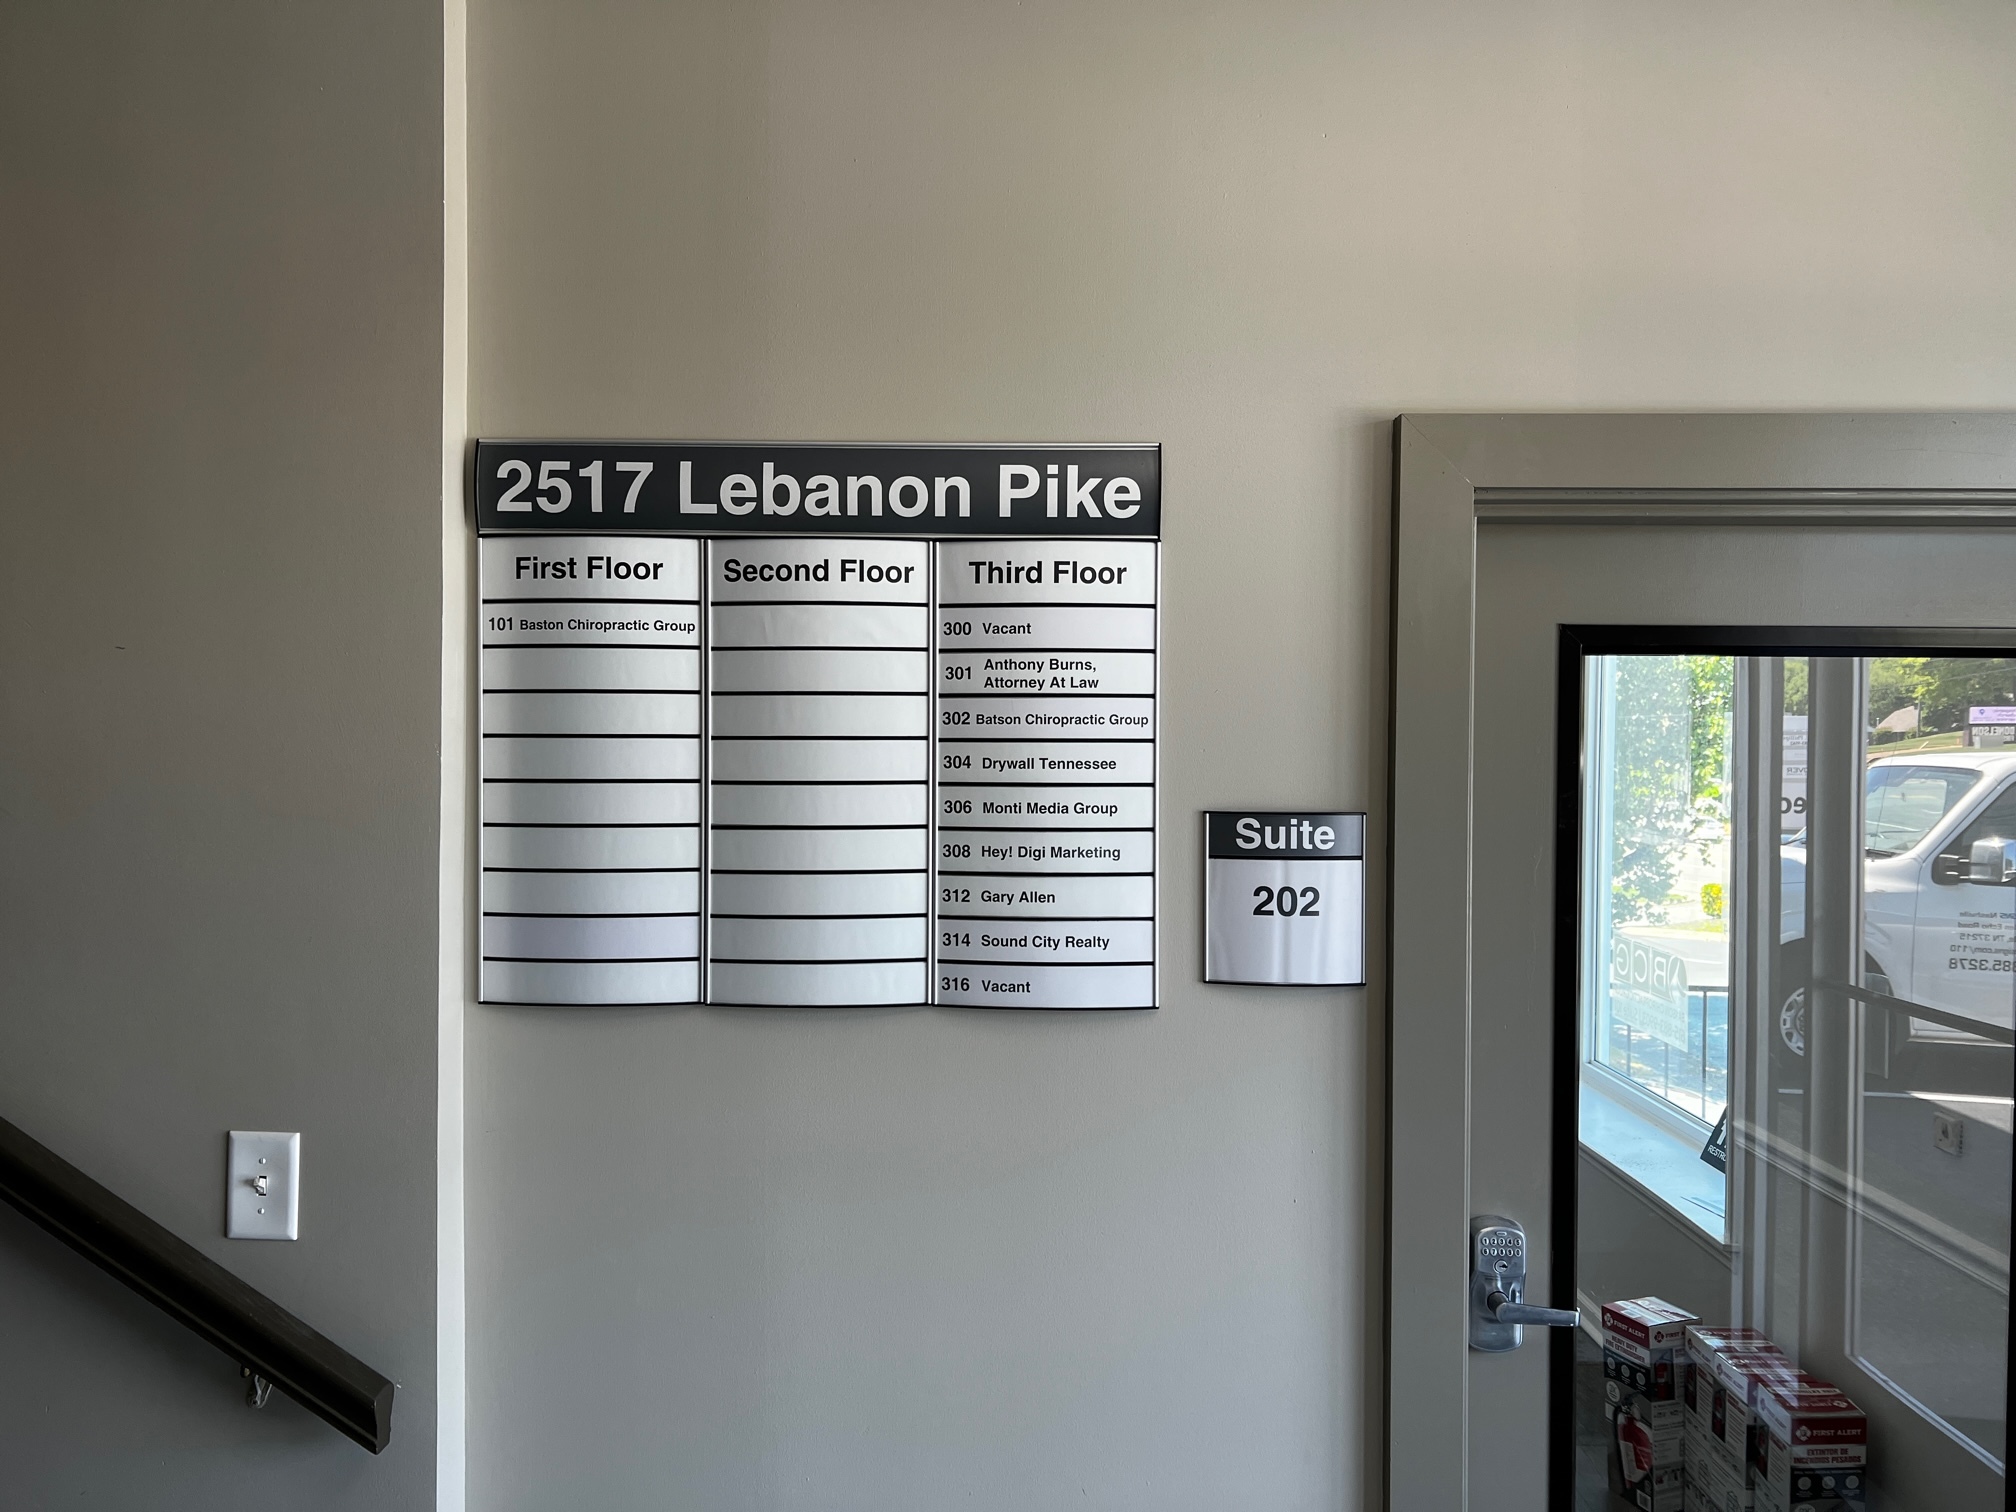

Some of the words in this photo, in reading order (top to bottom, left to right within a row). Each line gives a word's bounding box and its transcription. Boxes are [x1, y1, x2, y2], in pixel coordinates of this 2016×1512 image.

[497, 460, 653, 513] 2517
[680, 461, 970, 517] Lebanon
[1000, 465, 1141, 518] Pike
[516, 557, 577, 579] First
[588, 556, 663, 579] Floor
[724, 559, 828, 582] Second
[841, 559, 914, 583] Floor
[969, 561, 1042, 584] Third
[1054, 561, 1127, 584] Floor
[489, 617, 512, 630] 101
[520, 620, 563, 630] Baston
[568, 619, 649, 632] Chiropractic
[654, 620, 695, 634] Group
[944, 622, 971, 635] 300
[982, 623, 1031, 634] Vacant
[945, 667, 971, 680] 301
[984, 659, 1044, 673] Anthony
[1050, 659, 1095, 672] Burns,
[984, 677, 1045, 691] Attorney
[1050, 677, 1065, 688] At
[1071, 677, 1099, 688] Law
[943, 712, 970, 725] 302
[977, 714, 1020, 724] Batson
[1025, 714, 1105, 727] Chiropractic
[1109, 714, 1148, 727] Group
[944, 755, 971, 769] 304
[983, 758, 1034, 772] Drywall
[1039, 758, 1116, 769] Tennessee
[944, 800, 972, 813] 306
[983, 802, 1021, 813] Monti
[1027, 803, 1068, 814] Media
[1074, 803, 1117, 816] Group
[1236, 817, 1335, 850] Suite
[943, 844, 970, 858] 308
[982, 846, 1012, 860] Hey!
[1018, 846, 1045, 861] Digi
[1051, 847, 1120, 861] Marketing
[943, 889, 970, 902] 312
[981, 890, 1014, 905] Gary
[1019, 891, 1055, 903] Allen
[1253, 886, 1319, 916] 202
[943, 933, 970, 946] 314
[982, 935, 1027, 947] Sound
[1032, 936, 1060, 950] City
[1066, 936, 1109, 950] Realty
[942, 977, 969, 991] 316
[982, 980, 1030, 992] Vacant
[1613, 1319, 1628, 1332] FIRST
[1628, 1326, 1646, 1338] ALERT
[1812, 1429, 1835, 1437] FIRST
[1836, 1428, 1862, 1436] ALERT
